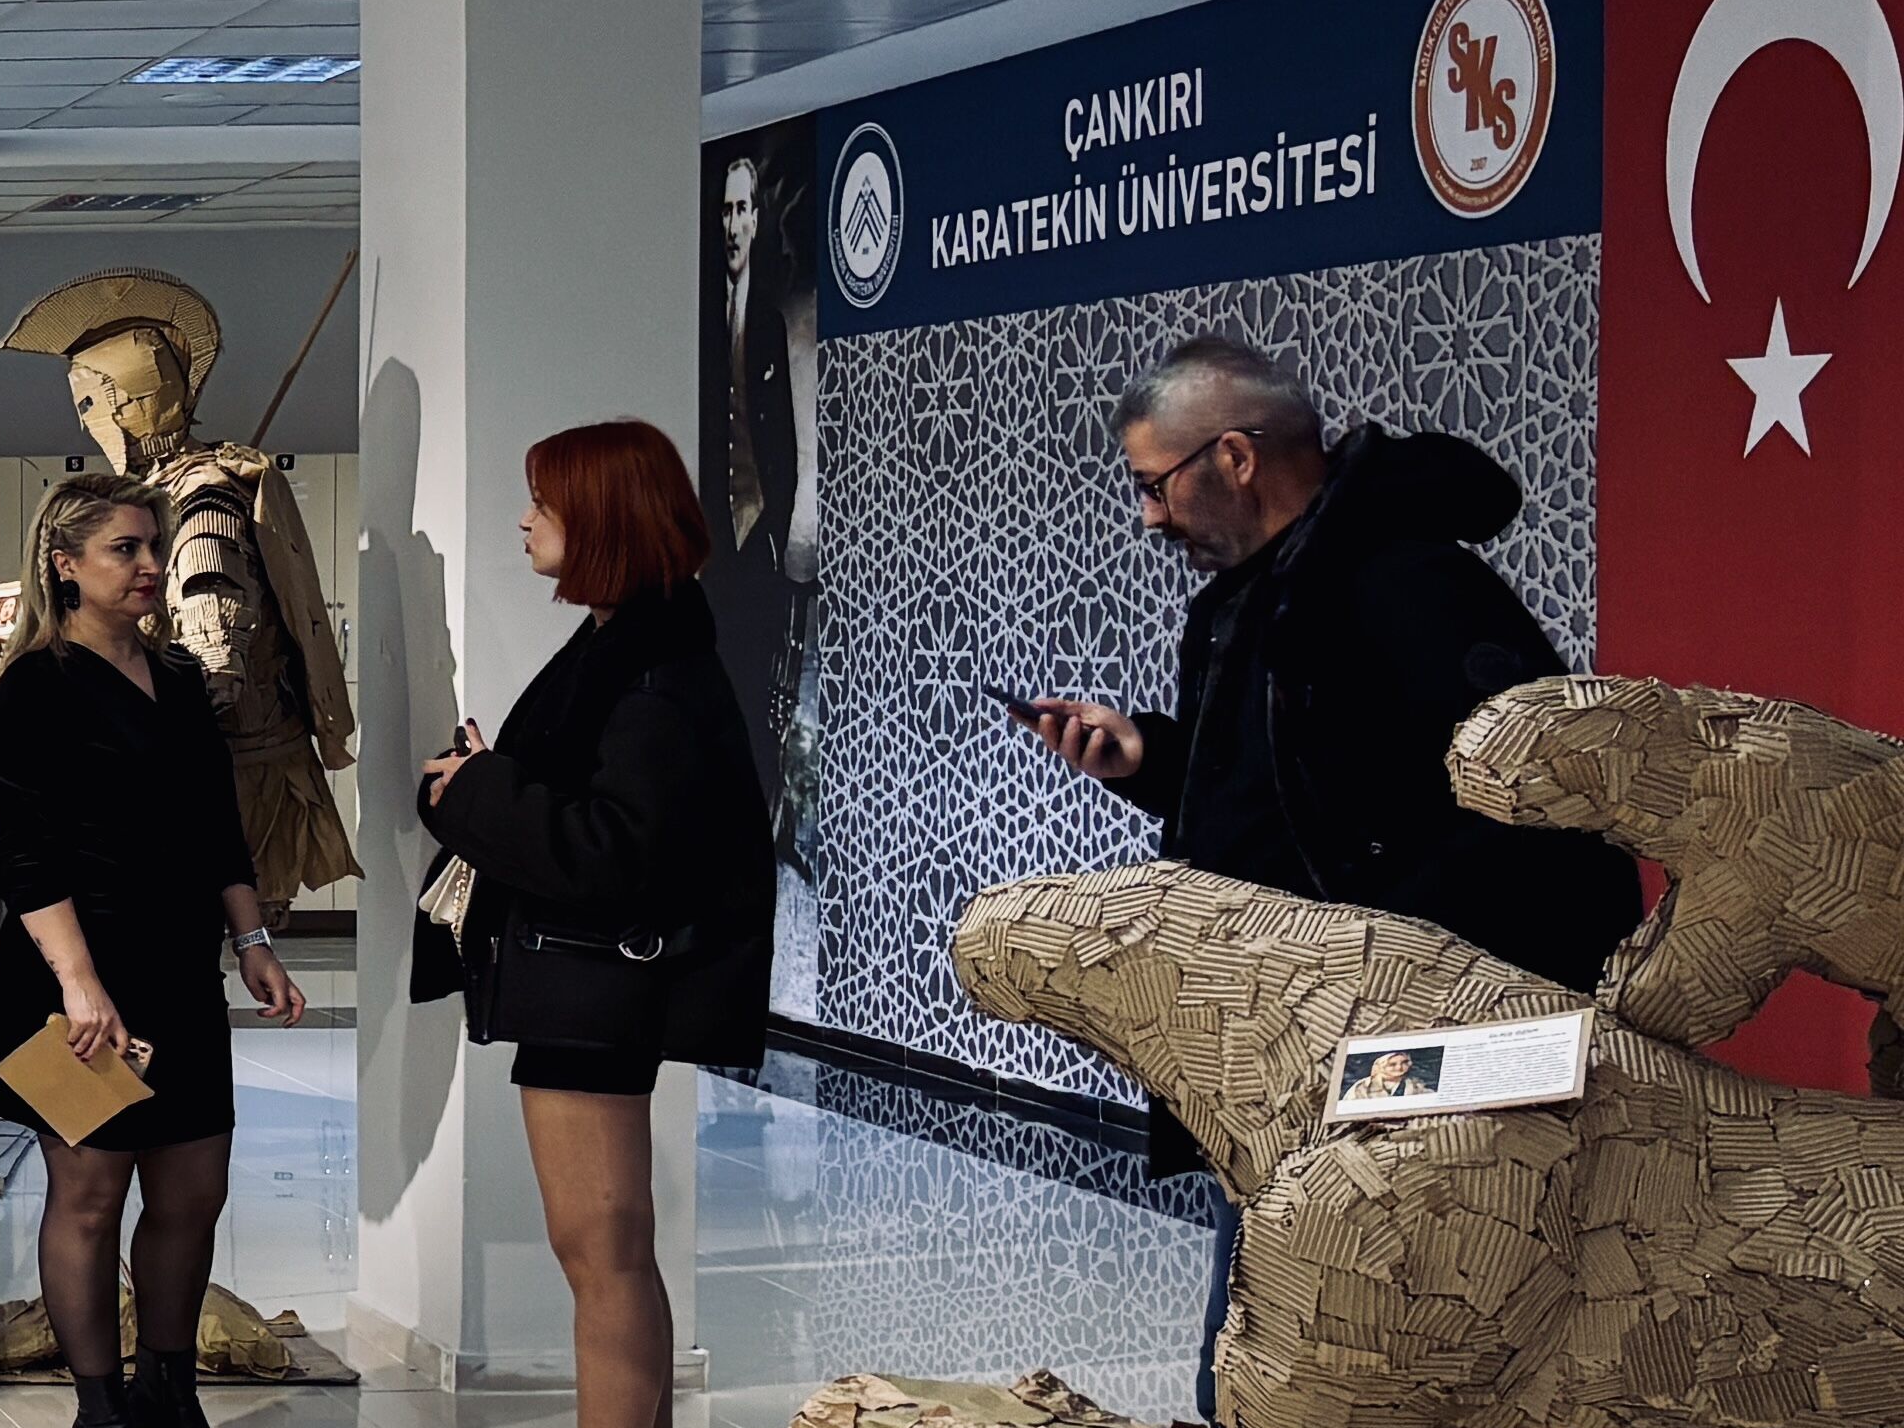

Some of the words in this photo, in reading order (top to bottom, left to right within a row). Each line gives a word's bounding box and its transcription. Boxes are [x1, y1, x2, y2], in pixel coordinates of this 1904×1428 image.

[1064, 67, 1204, 162] ÇANKIRI
[1448, 22, 1516, 150] SKS
[931, 174, 1107, 269] KARATEKİN
[1117, 112, 1378, 236] ÜNİVERSİTESİ
